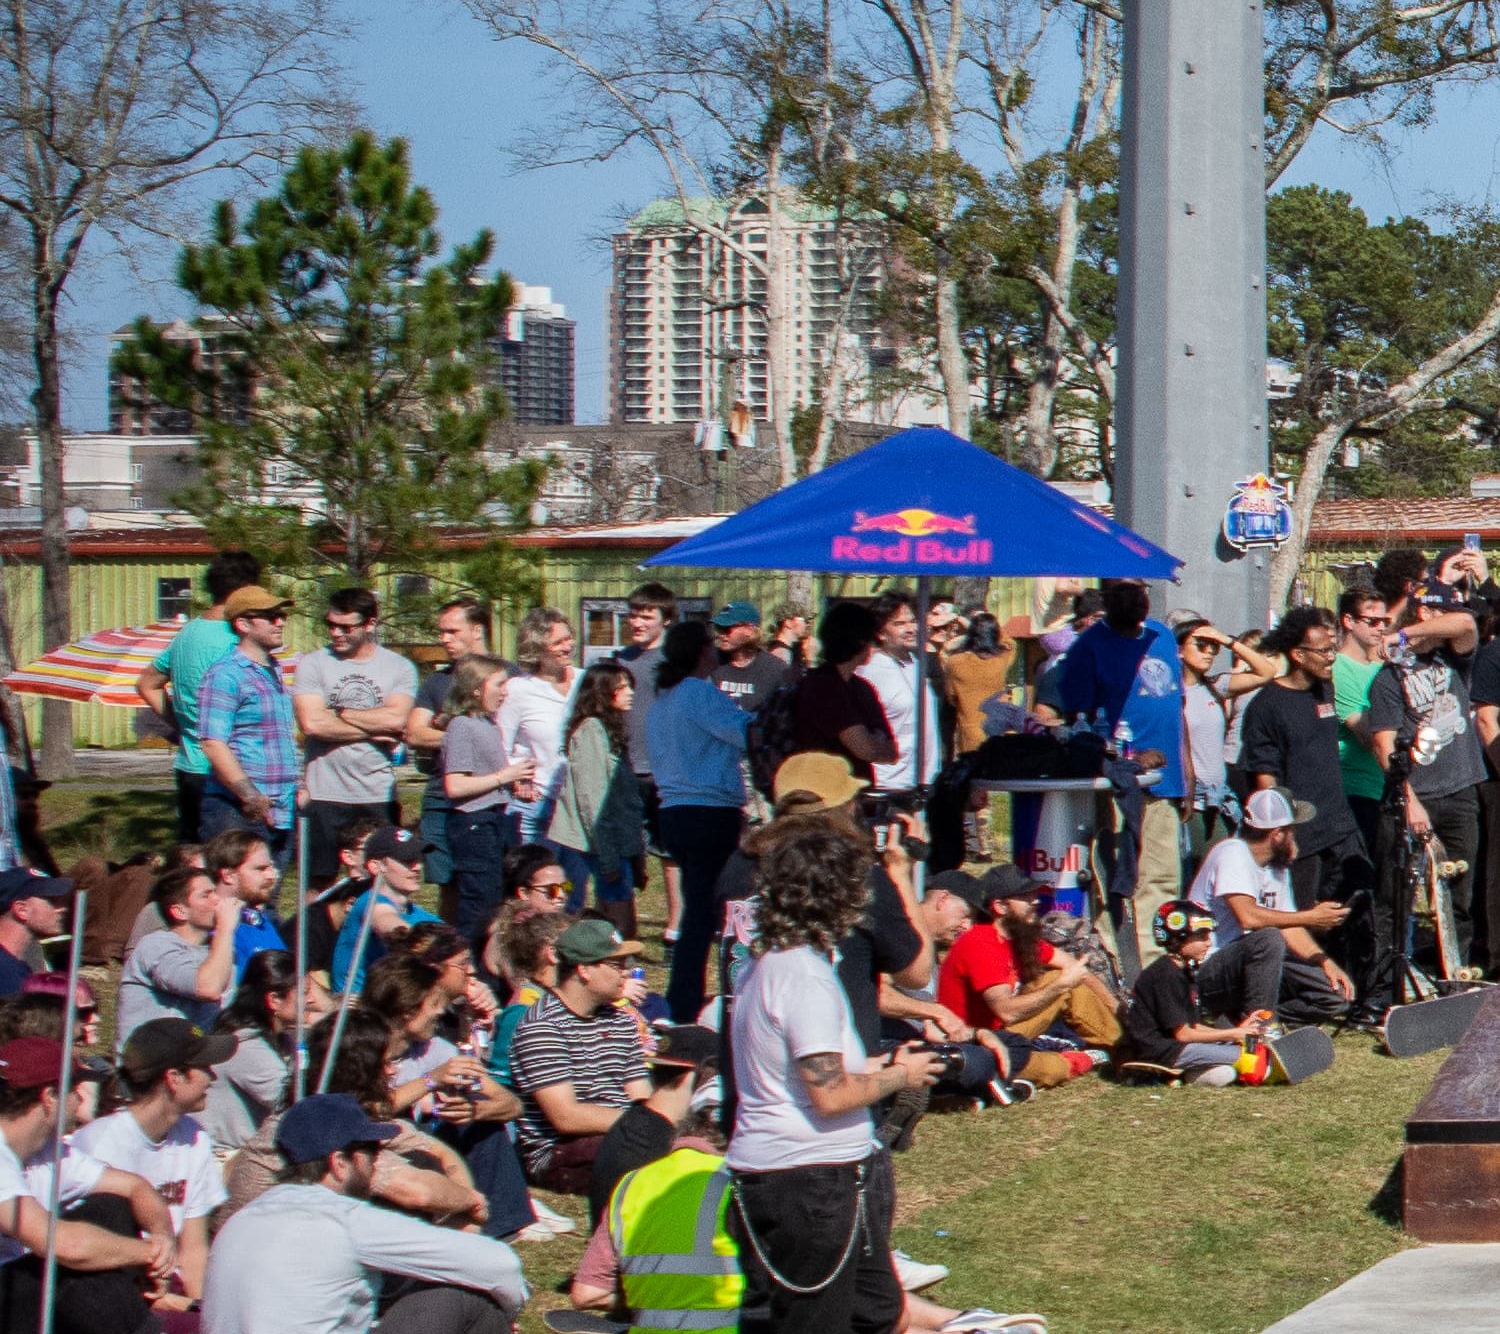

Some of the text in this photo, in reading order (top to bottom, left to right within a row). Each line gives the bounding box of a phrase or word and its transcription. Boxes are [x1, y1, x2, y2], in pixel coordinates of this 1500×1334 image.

[832, 536, 995, 564] Red Bull
[1033, 848, 1080, 872] Bull
